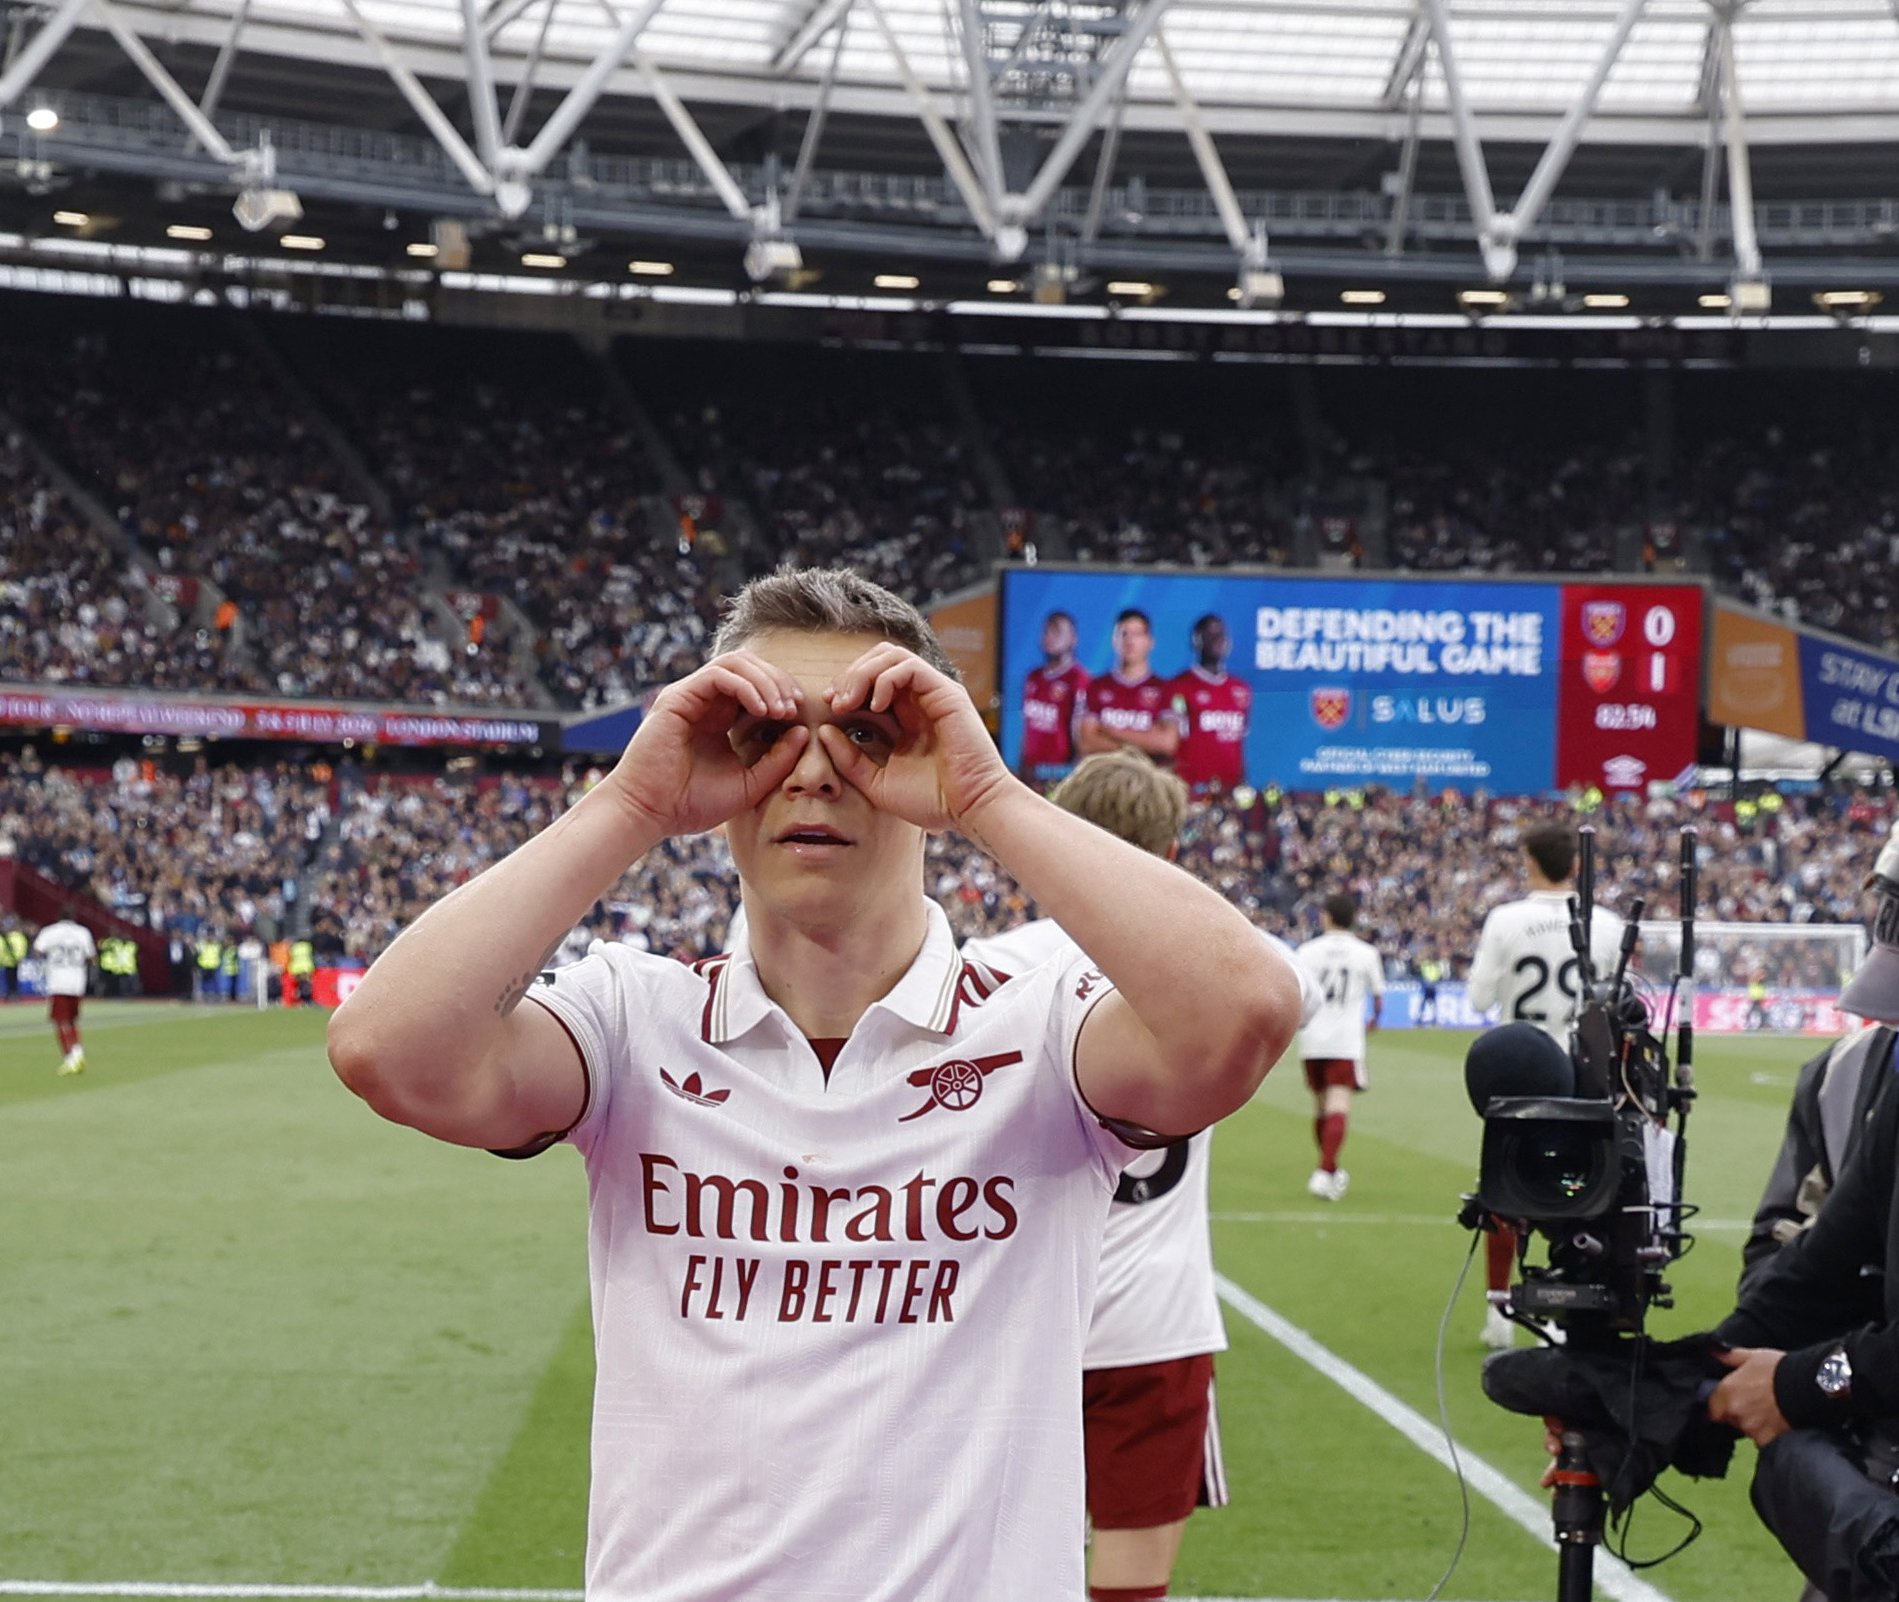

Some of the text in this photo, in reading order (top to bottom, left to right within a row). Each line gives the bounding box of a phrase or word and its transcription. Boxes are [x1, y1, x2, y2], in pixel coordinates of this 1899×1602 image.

[1256, 606, 1544, 645] DEFENDING THE
[1644, 605, 1675, 646] 0
[1255, 639, 1542, 675] BEAUTIFUL GAME
[1650, 651, 1666, 691] 1
[1818, 652, 1887, 696] STAY
[639, 1153, 1018, 1243] Emirates
[681, 1255, 960, 1324] FLY BETTER
